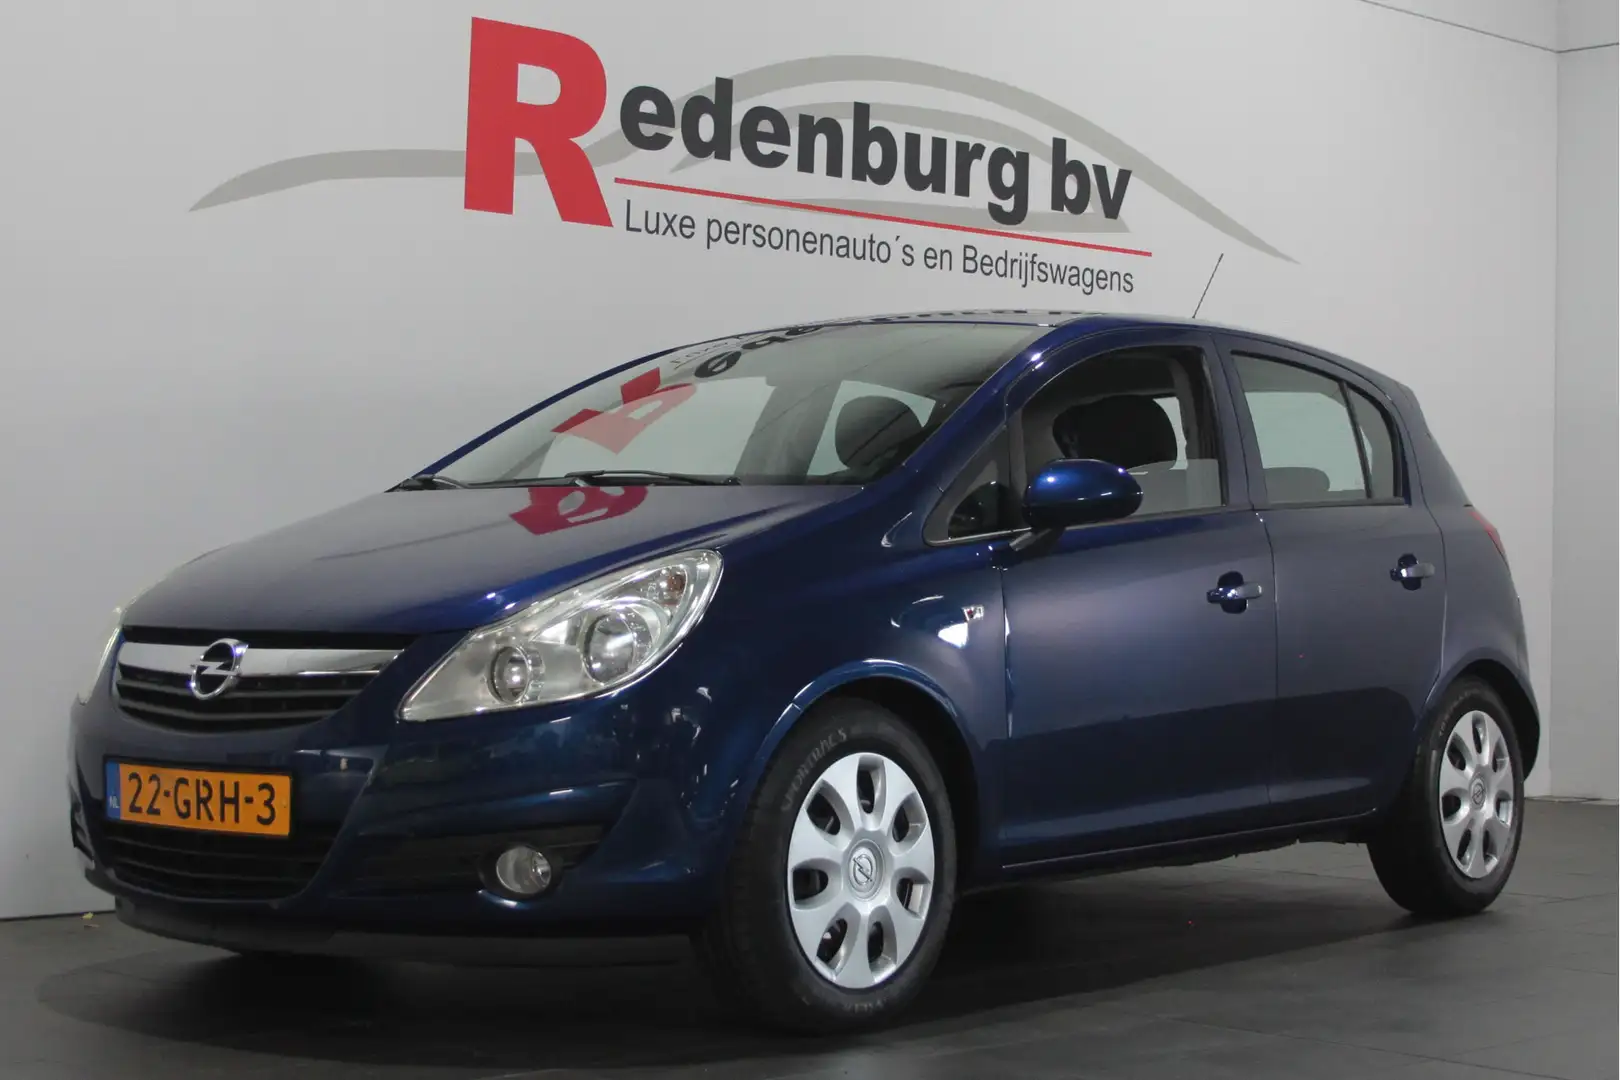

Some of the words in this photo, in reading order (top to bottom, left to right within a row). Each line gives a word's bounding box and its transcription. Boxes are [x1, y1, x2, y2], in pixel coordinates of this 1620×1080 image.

[464, 17, 1030, 226] Redenburg
[1050, 137, 1133, 220] bv
[625, 199, 696, 239] Luxe
[924, 247, 953, 271] en
[962, 244, 1134, 296] Bedrijfswagens
[109, 795, 121, 809] NL
[128, 771, 277, 826] 22-GRH-3
